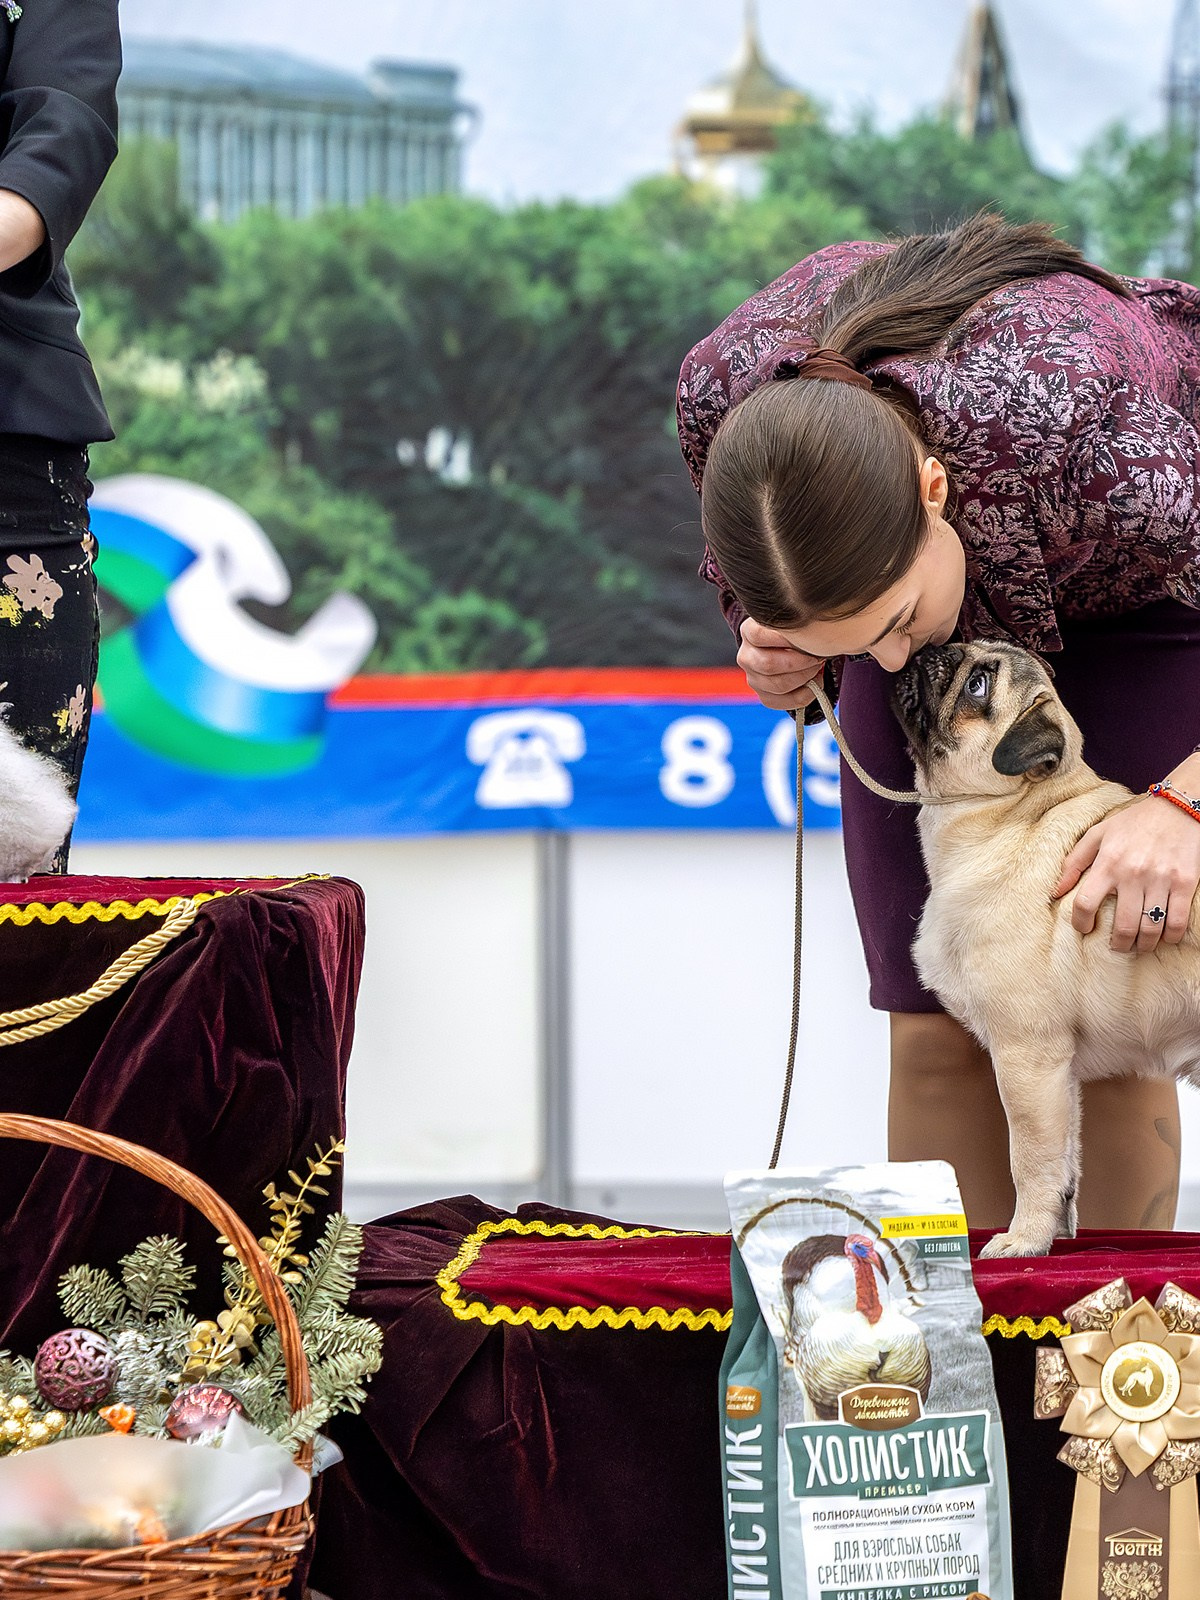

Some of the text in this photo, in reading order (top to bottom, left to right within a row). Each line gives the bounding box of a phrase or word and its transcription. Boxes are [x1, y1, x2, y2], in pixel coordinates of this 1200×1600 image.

[659, 714, 736, 809] 8
[924, 1243, 935, 1254] БЕЗ
[849, 1394, 910, 1413] Деревенские
[802, 1424, 976, 1489] ХОЛИСТИК
[864, 1484, 922, 1498] ПРЕМЬЕР
[725, 1423, 771, 1600] ИСТИК
[812, 1500, 975, 1522] ПОЛНОРАЦИОННЫЙ СУХОЙ КОРМ
[834, 1532, 962, 1563] ДЛЯ ВЗРОСЛЫХ СОБАК
[818, 1554, 980, 1586] СРЕДНИХ И КРУПНЫХ ПОРОД
[837, 1582, 967, 1600] ИНДЕЙКА С РИСОМ
